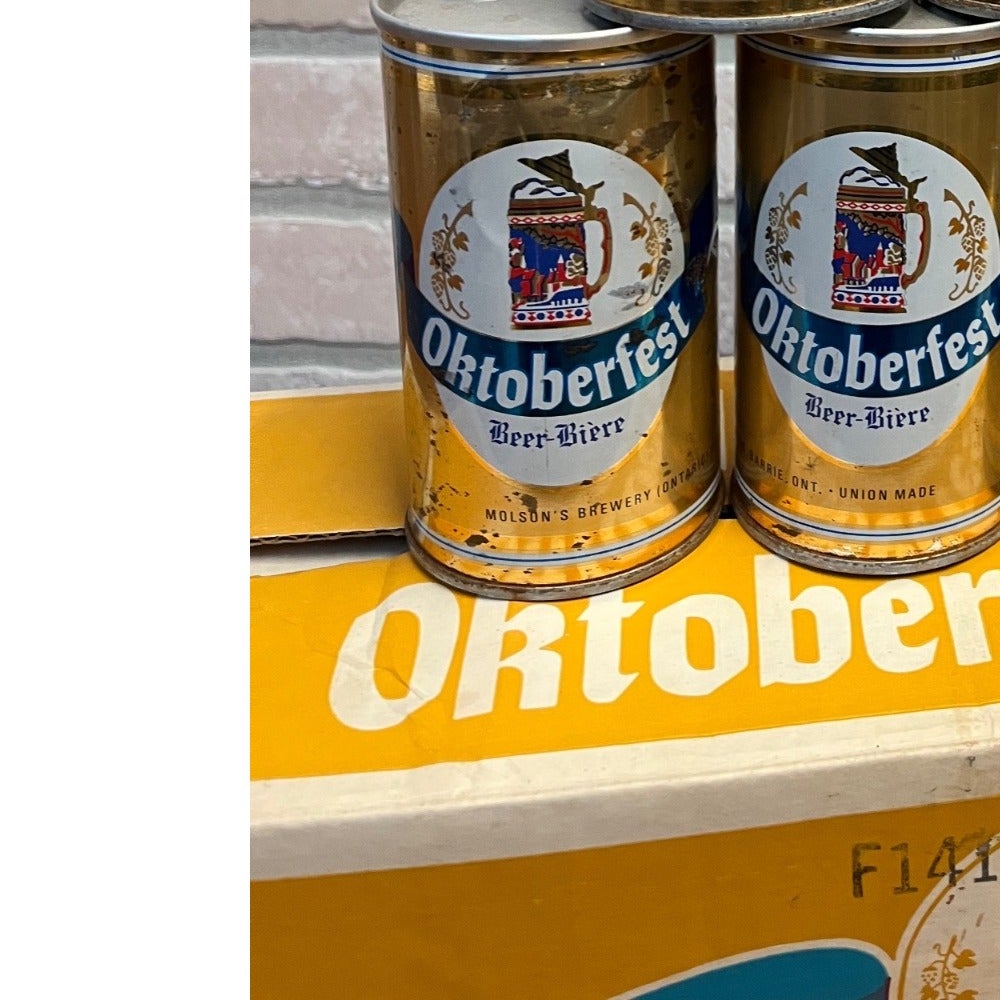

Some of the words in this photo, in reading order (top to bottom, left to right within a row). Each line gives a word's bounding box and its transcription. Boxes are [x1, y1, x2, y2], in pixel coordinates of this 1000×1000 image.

[421, 300, 691, 411] Oktoberfest
[804, 392, 931, 431] Beer-Bière
[488, 416, 626, 450] Beer-Bière
[791, 475, 823, 495] ONT.
[838, 487, 888, 501] UNION
[894, 484, 937, 501] MADE
[485, 508, 570, 524] MOLSON'S
[577, 491, 652, 520] BREWERY
[850, 836, 998, 898] F141
